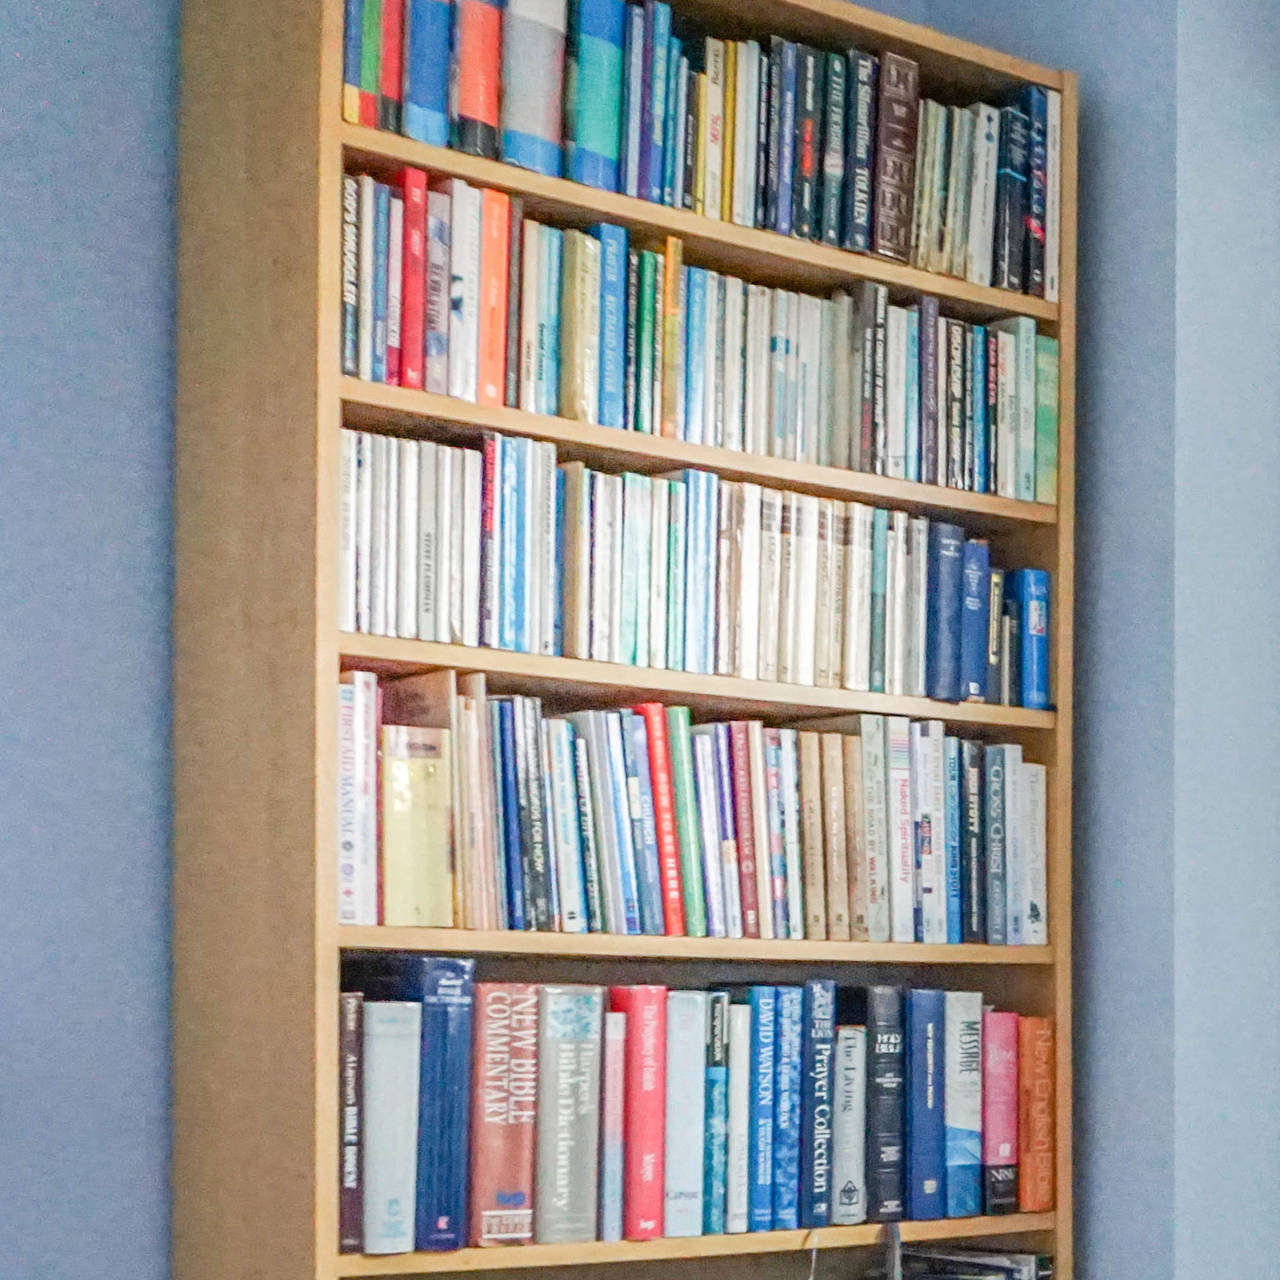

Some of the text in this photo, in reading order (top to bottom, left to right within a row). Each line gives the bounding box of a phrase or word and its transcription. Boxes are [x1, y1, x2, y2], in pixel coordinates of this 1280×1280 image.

[856, 58, 869, 159] The Silmarillion
[854, 167, 869, 226] TOLKIEN
[343, 178, 358, 305] GOD'S SMUGGLER
[341, 775, 355, 835] MANUAL
[533, 822, 542, 841] FOR
[641, 796, 655, 844] CHURCH
[659, 774, 679, 899] HOW TO BE HERE
[867, 809, 875, 837] ROAD
[898, 779, 911, 883] Naked Spirituality
[990, 766, 1004, 874] CROSS CHRIST
[534, 842, 545, 872] NOW
[868, 840, 876, 853] BY
[869, 857, 877, 904] WALKING
[645, 1005, 656, 1020] The
[960, 1021, 980, 1073] MESSAGE
[484, 991, 511, 1125] COMMENTARY
[509, 993, 537, 1124] NEW BIBLE
[574, 1043, 595, 1114] Harper's
[758, 998, 773, 1105] DAVID WATSON
[841, 1034, 858, 1112] The Living
[1034, 1030, 1052, 1073] New
[552, 1043, 577, 1212] Bible Dictionary
[810, 1044, 832, 1193] Prayer Collection
[1033, 1079, 1053, 1149] English
